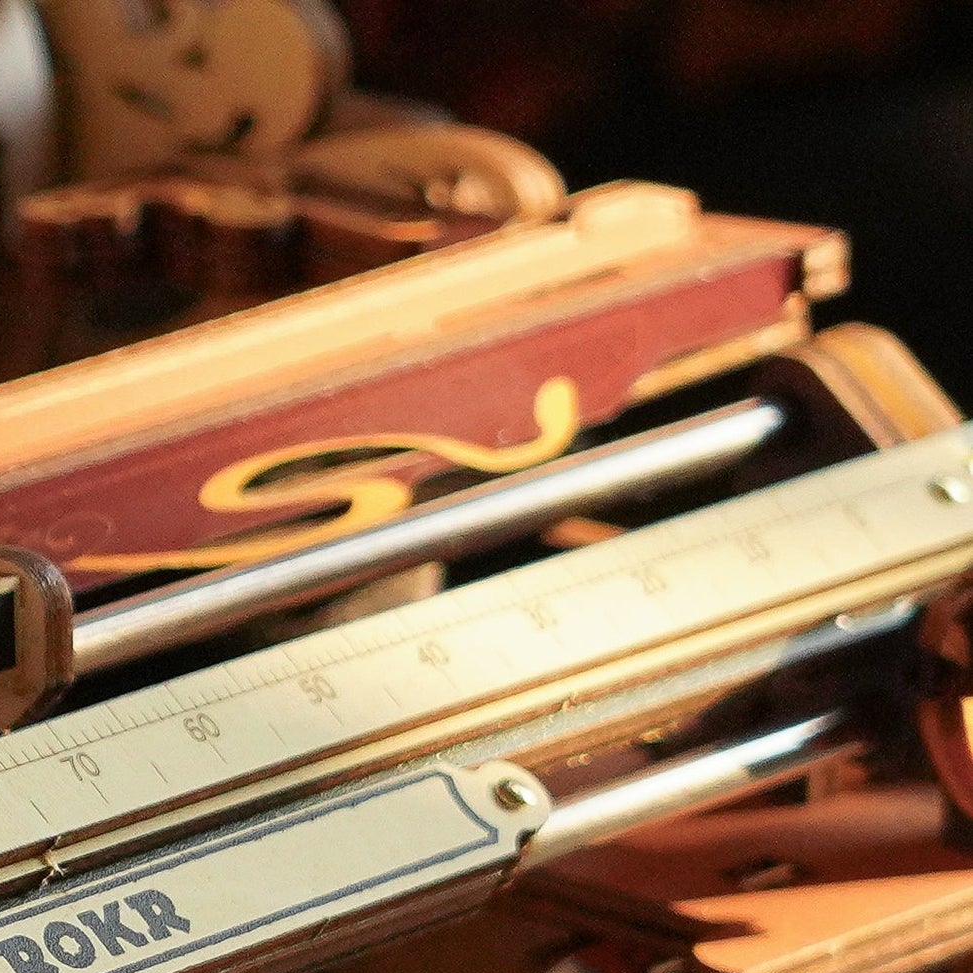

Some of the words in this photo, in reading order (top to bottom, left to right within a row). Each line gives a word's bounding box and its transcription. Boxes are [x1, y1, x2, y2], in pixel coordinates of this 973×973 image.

[60, 751, 100, 783] 70
[182, 713, 220, 743] 60
[295, 674, 338, 706] 50
[416, 639, 450, 668] 40
